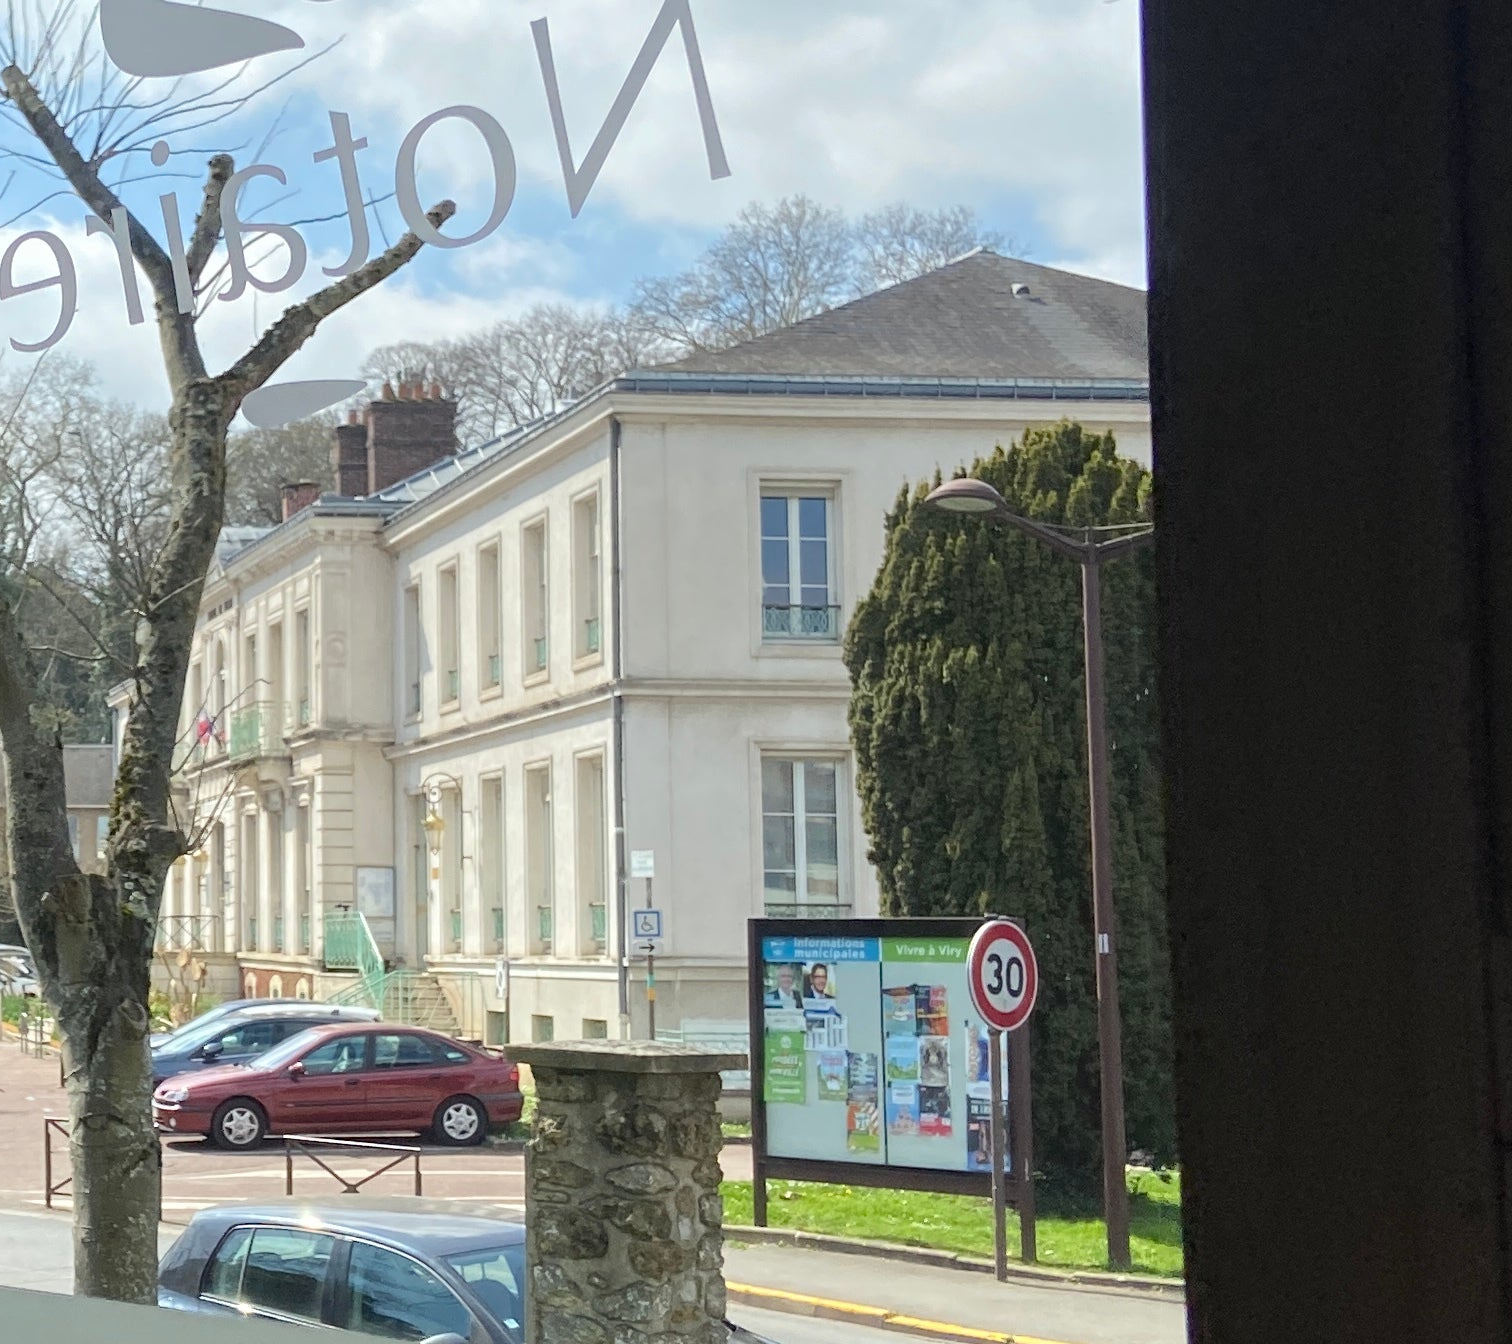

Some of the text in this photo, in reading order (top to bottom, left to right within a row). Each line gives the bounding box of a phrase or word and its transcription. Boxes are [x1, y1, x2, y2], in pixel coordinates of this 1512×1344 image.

[794, 947, 866, 959] municipales
[896, 944, 962, 958] Vivre à Viry
[987, 953, 1024, 998] 30
